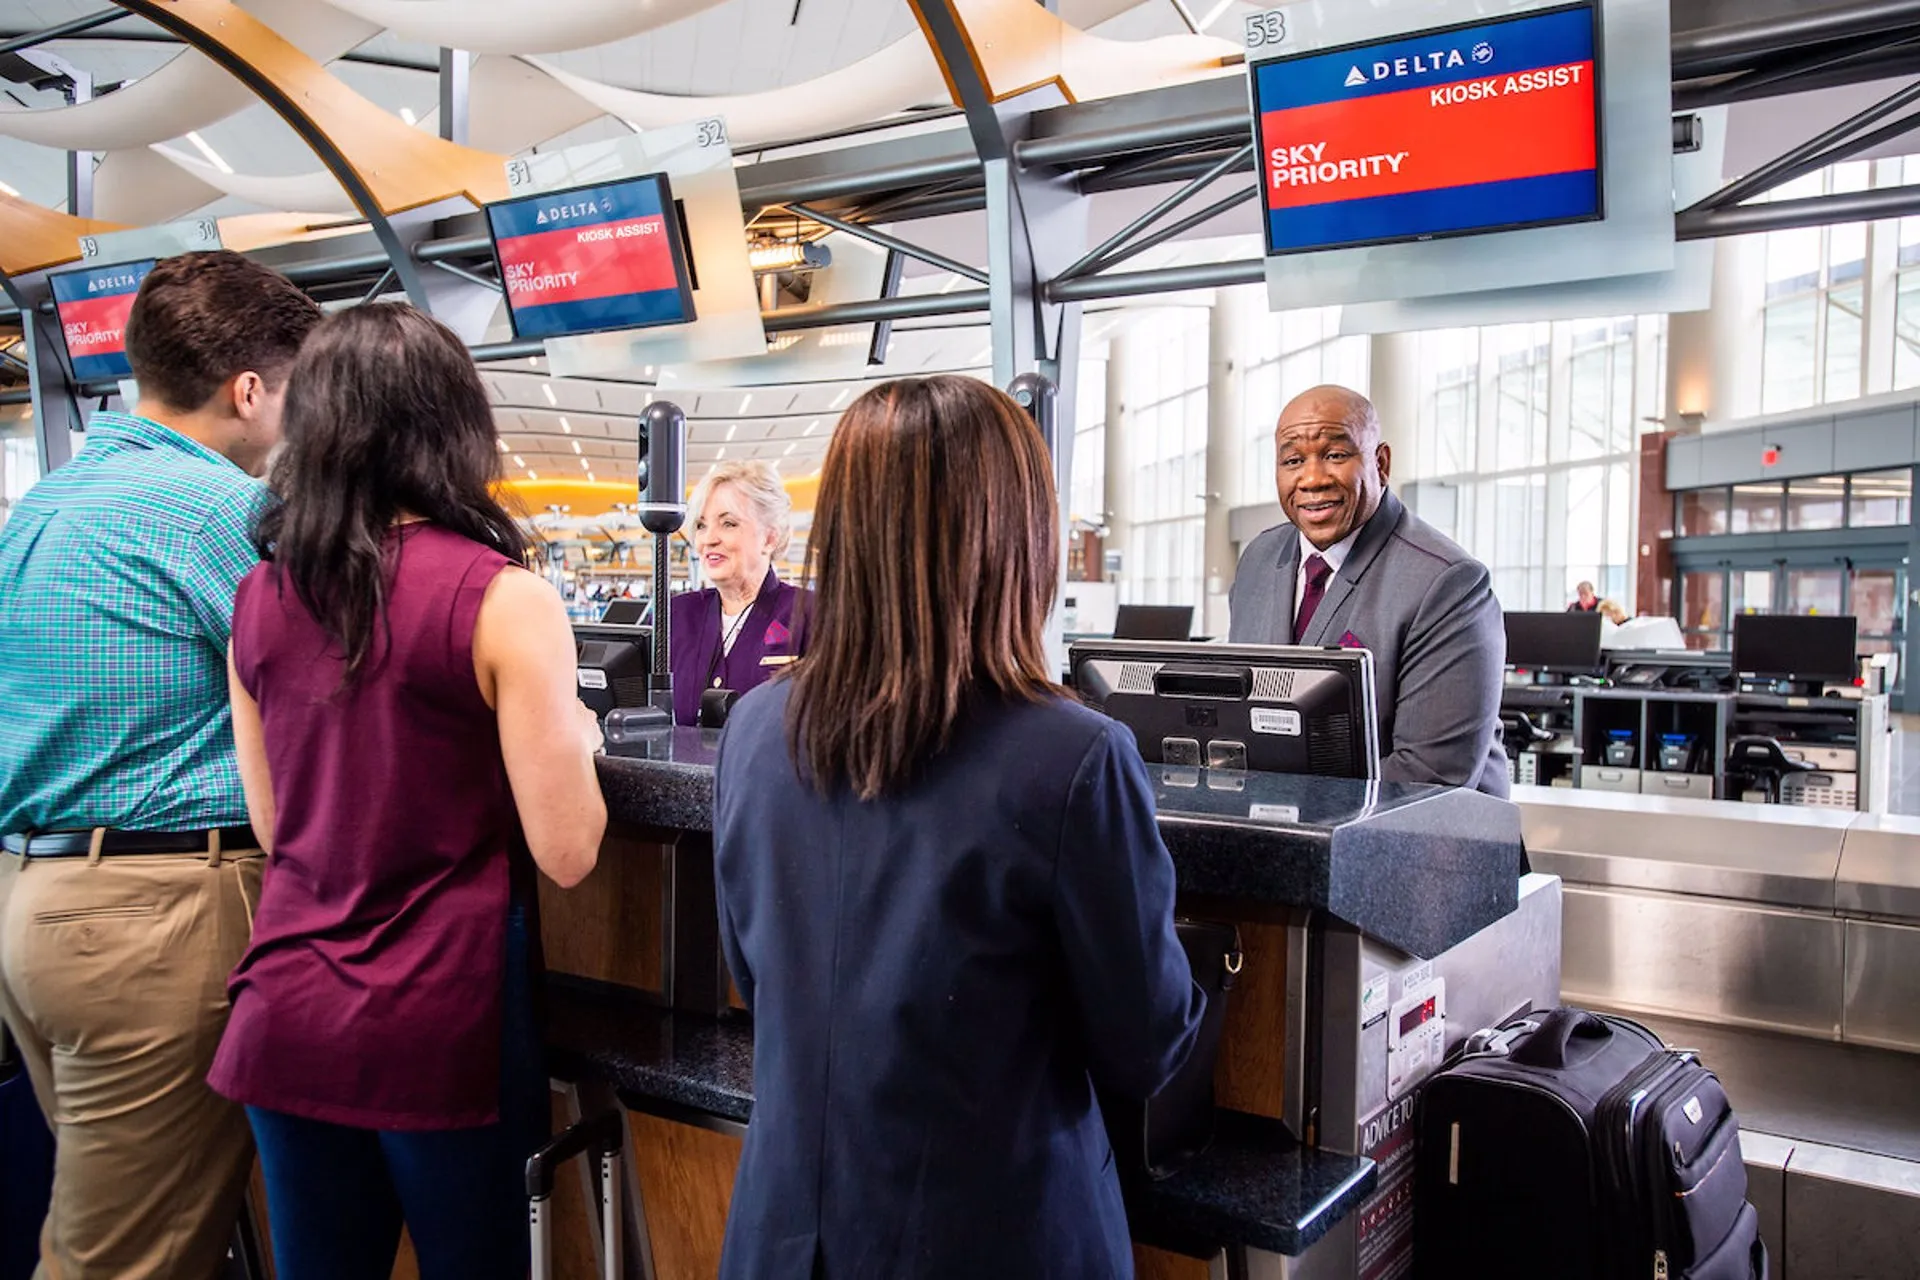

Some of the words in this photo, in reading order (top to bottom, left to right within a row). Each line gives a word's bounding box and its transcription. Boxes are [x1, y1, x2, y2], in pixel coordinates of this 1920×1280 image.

[1246, 11, 1286, 48] 53
[1373, 49, 1465, 80] DELTA
[1430, 80, 1498, 107] KIOSK
[1503, 65, 1583, 95] ASSIST
[696, 119, 725, 148] 52
[1271, 142, 1326, 168] SKY
[508, 160, 531, 186] 51
[1272, 151, 1406, 189] PRIORITY
[550, 202, 598, 221] DELTA
[196, 219, 216, 241] 50
[577, 228, 614, 243] KIOSK
[616, 222, 660, 238] ASSIST
[98, 275, 136, 290] DELTA
[505, 262, 535, 279] SKY
[508, 271, 578, 294] PRIORITY
[65, 321, 87, 335] SKY
[67, 329, 120, 345] PRIORITY
[1362, 1104, 1399, 1156] ADVICE
[1400, 1095, 1414, 1124] TO
